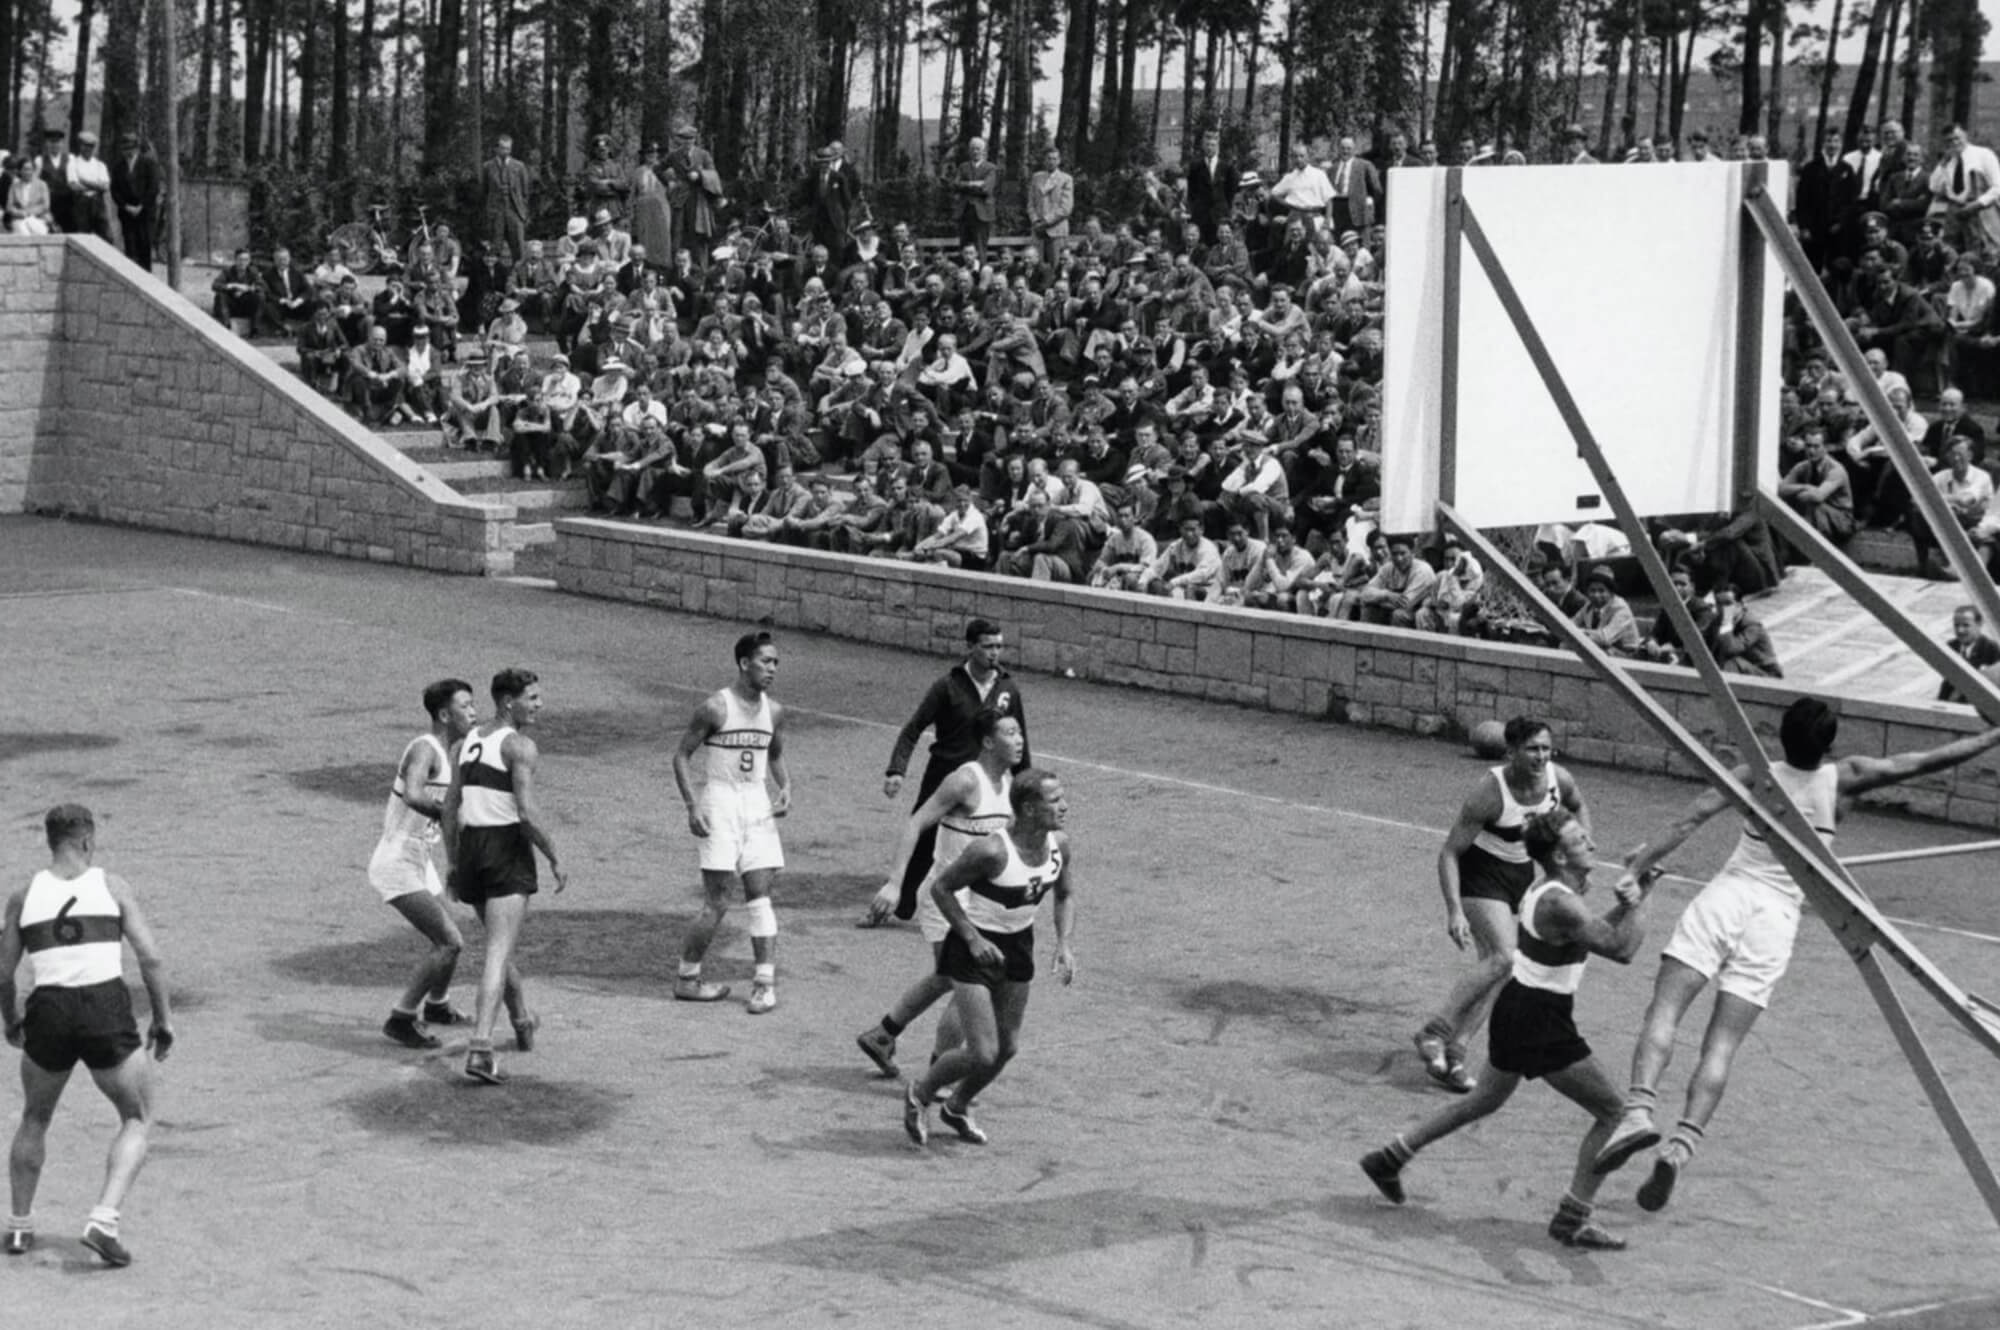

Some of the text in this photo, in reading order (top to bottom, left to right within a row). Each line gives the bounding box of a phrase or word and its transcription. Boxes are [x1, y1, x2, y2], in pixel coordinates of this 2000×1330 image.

[740, 750, 754, 772] 9
[1051, 849, 1060, 875] 5
[53, 896, 84, 945] 6
